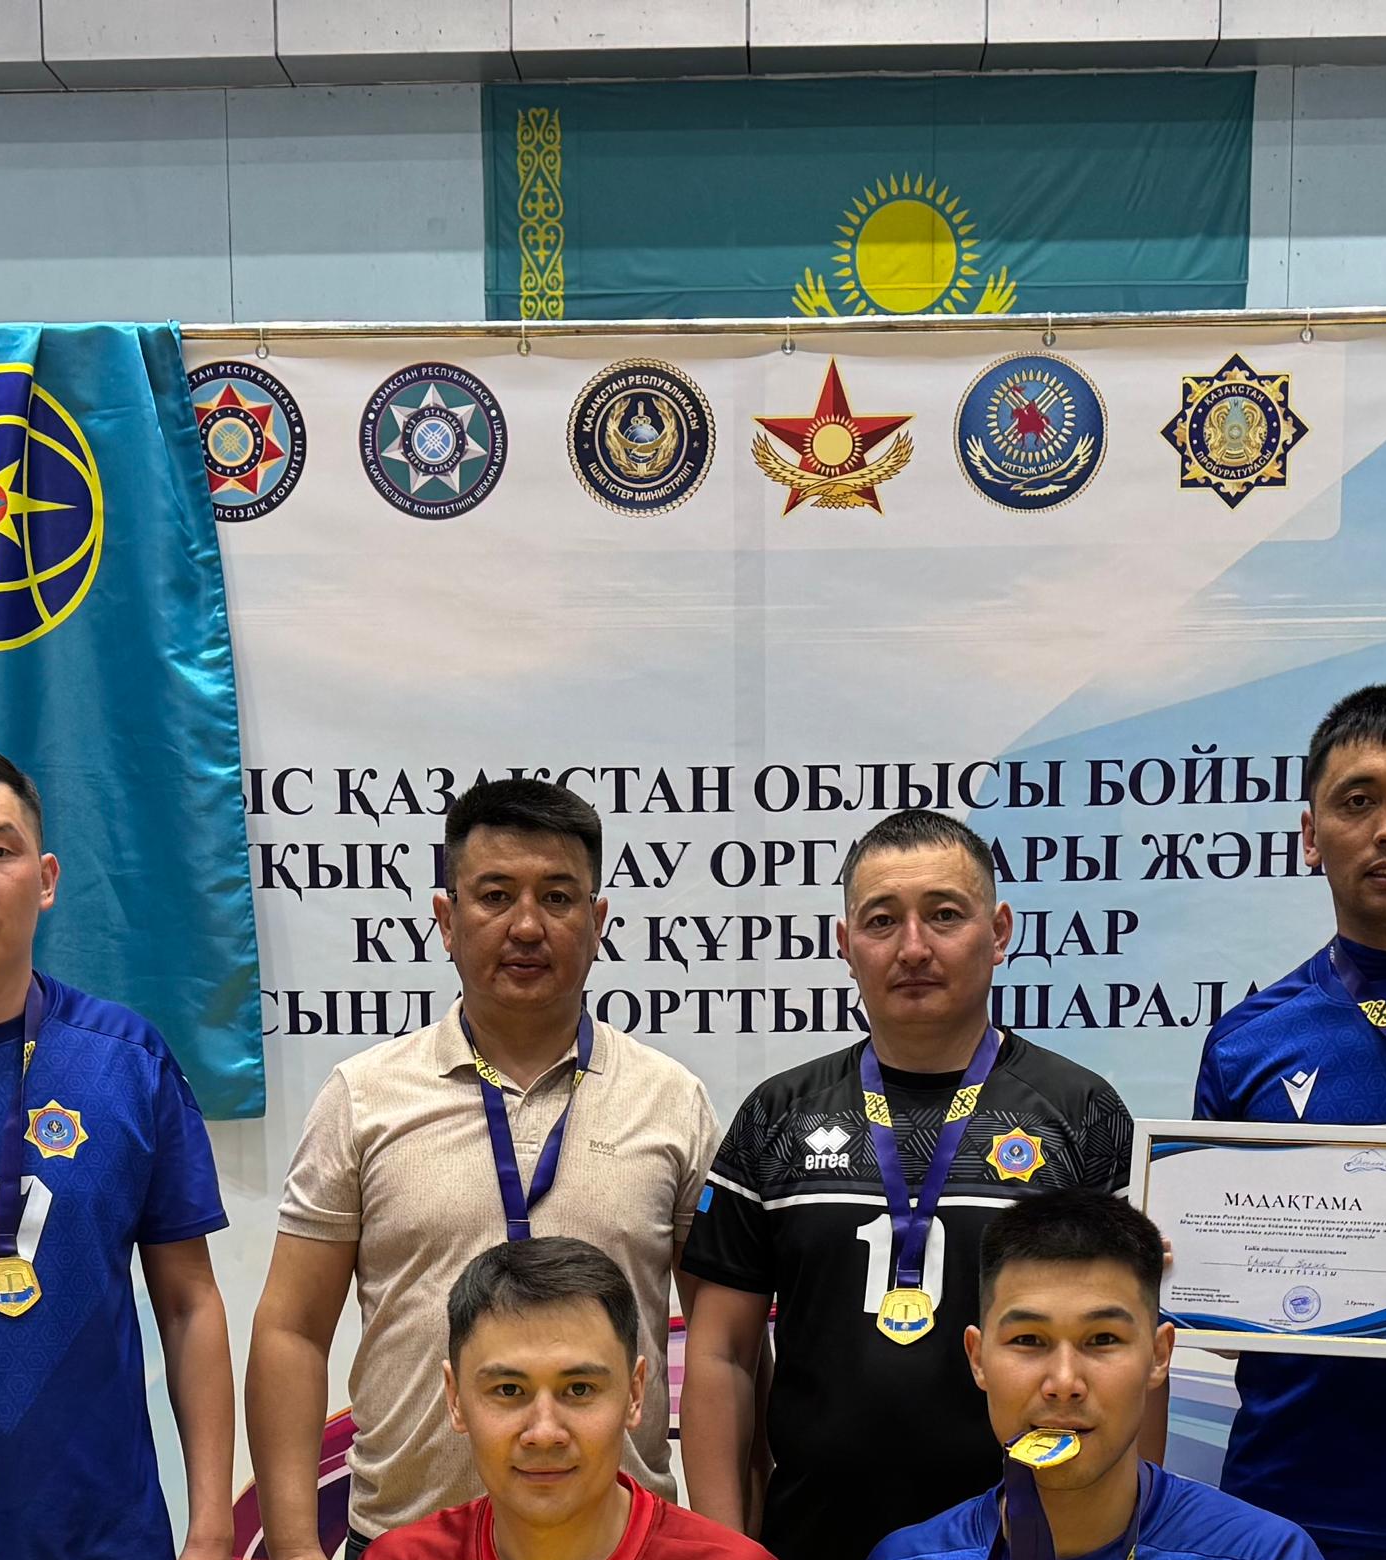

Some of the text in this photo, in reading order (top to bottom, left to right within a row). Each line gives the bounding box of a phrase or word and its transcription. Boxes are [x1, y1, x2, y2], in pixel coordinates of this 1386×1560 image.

[219, 365, 299, 421] РЕСПУБЛИКАСЫ
[421, 366, 493, 407] РЕСПУБЛИКАСЫ
[582, 374, 700, 432] ҚАЗАҚСТАН РЕСПУБЛИКАСЫ
[216, 440, 303, 519] ПСІЗДІК КОМИТЕТІ
[474, 465, 499, 499] ШЕКАРА
[1195, 449, 1273, 478] ПРОКУРАТУРАСЫ
[754, 760, 1066, 812] ОБЛЫСЫ
[248, 843, 412, 902] ҚЫҚ
[1140, 831, 1327, 880] ЖӘН
[1223, 1192, 1363, 1212] МАДАҚТАМА
[856, 1212, 946, 1315] 10
